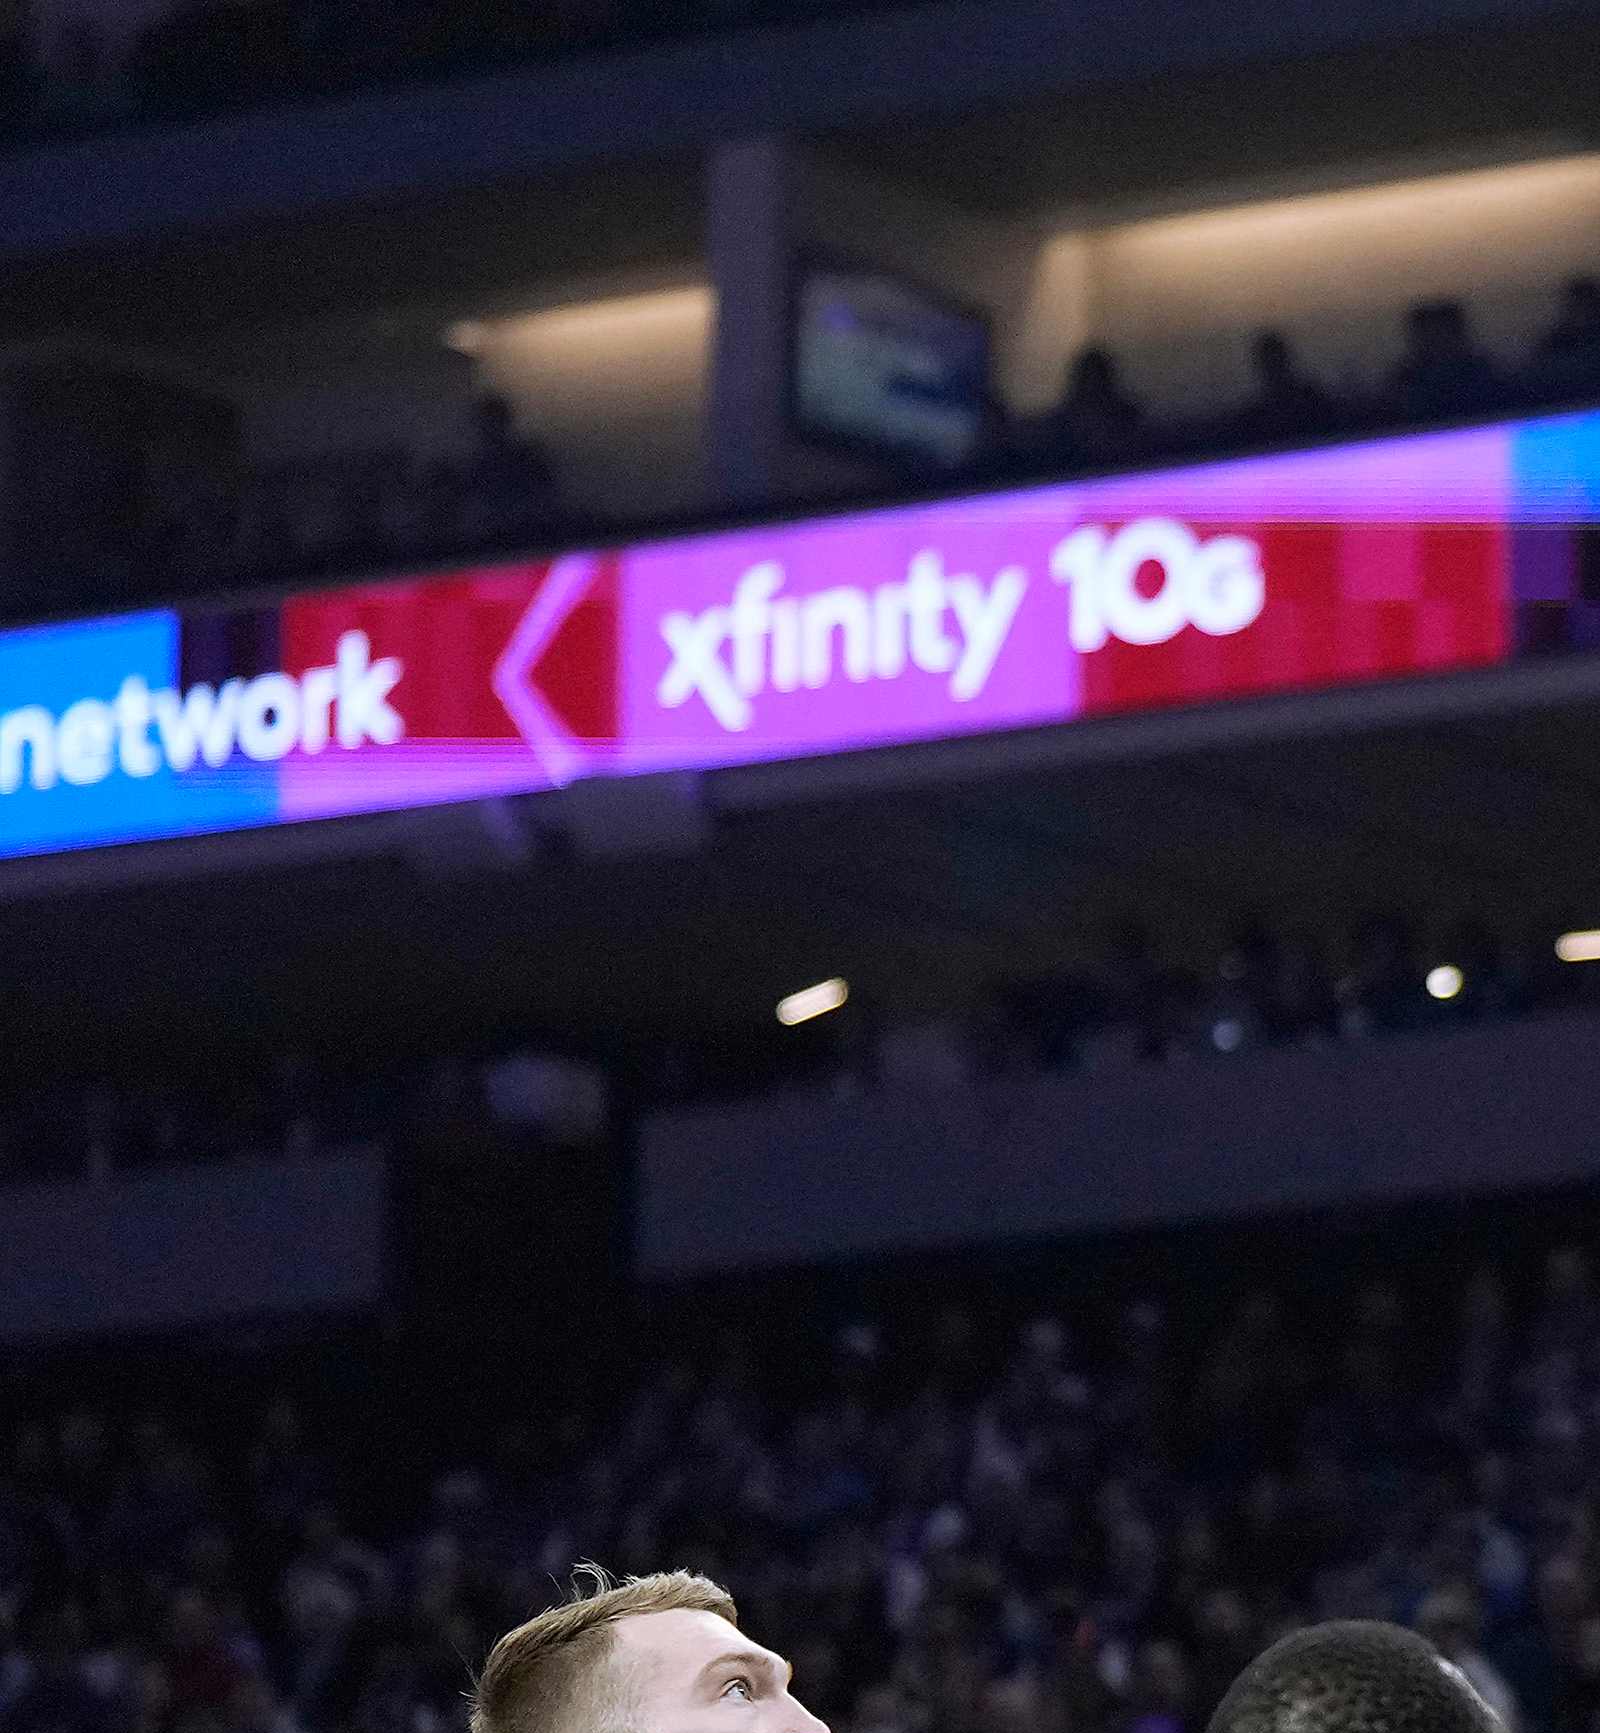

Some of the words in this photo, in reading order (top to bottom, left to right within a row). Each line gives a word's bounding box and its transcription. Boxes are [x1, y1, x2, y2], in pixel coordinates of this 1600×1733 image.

[0, 629, 404, 795] network
[656, 549, 1028, 731] xfinity
[1050, 517, 1266, 654] 10G
